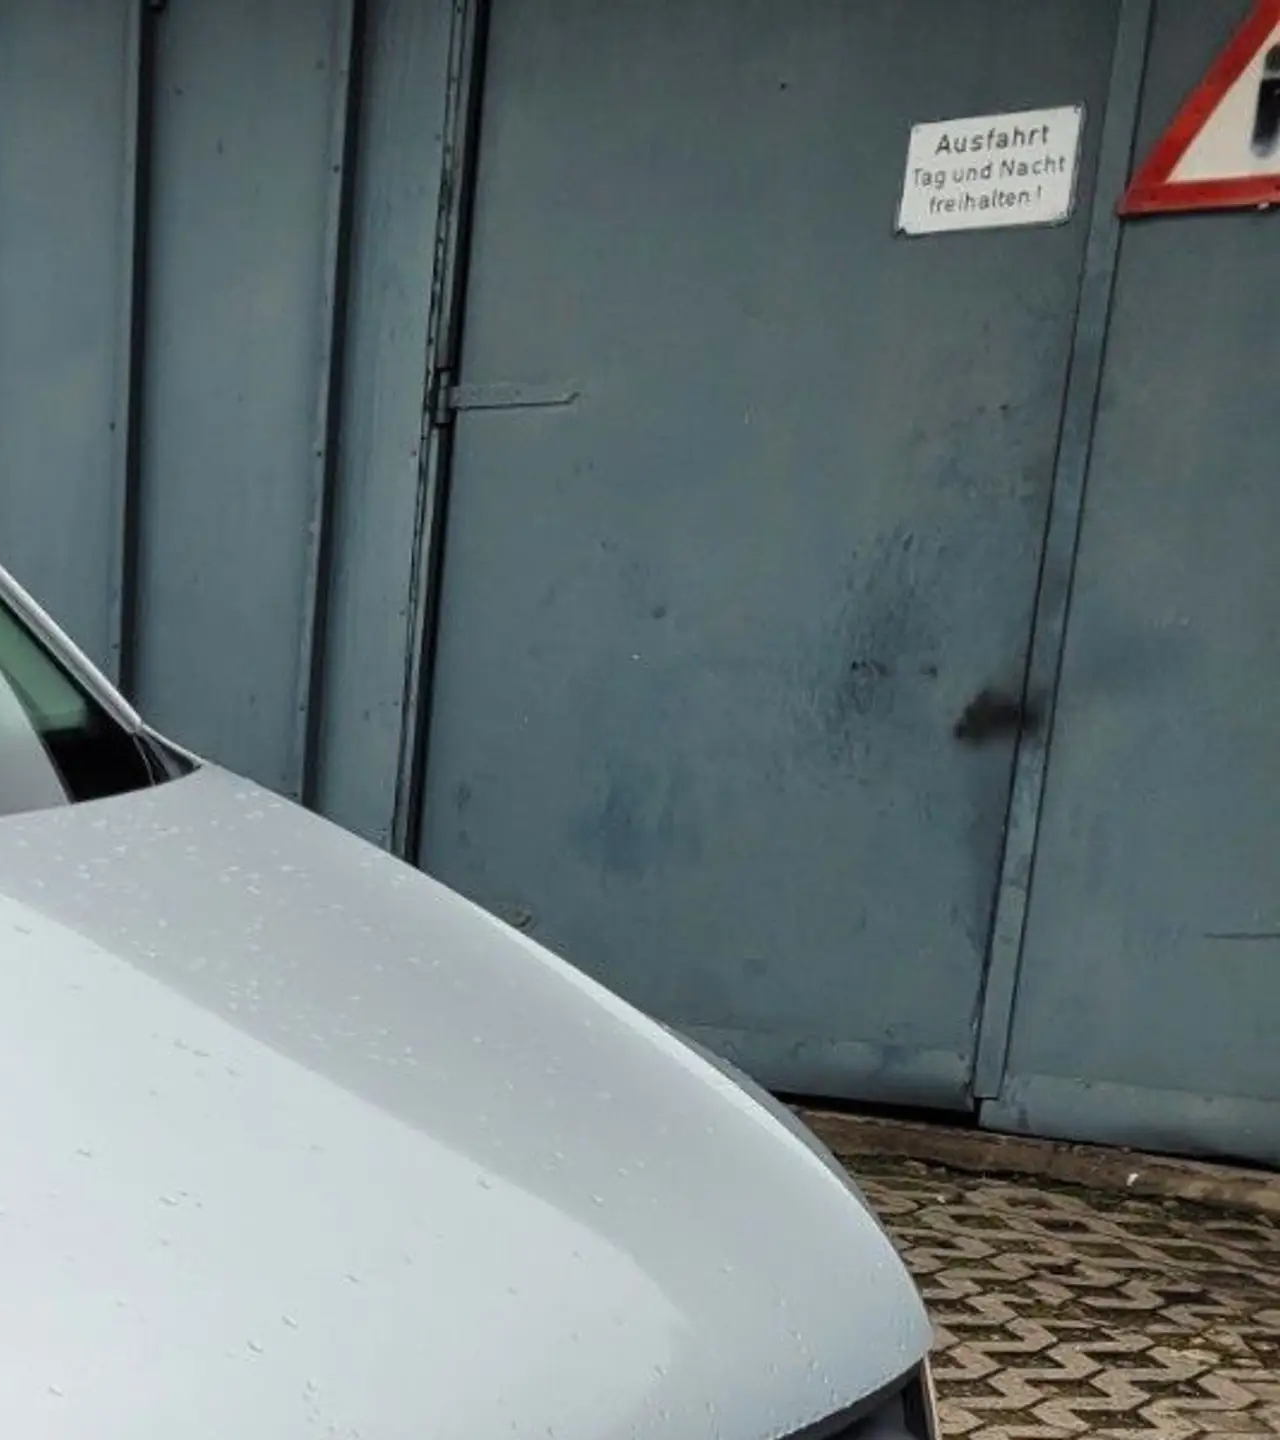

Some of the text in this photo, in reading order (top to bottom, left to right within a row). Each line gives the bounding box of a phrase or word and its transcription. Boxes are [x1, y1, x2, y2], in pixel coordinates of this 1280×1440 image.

[934, 123, 1050, 155] Ausfahrt
[913, 155, 1066, 189] Tag und Nacht
